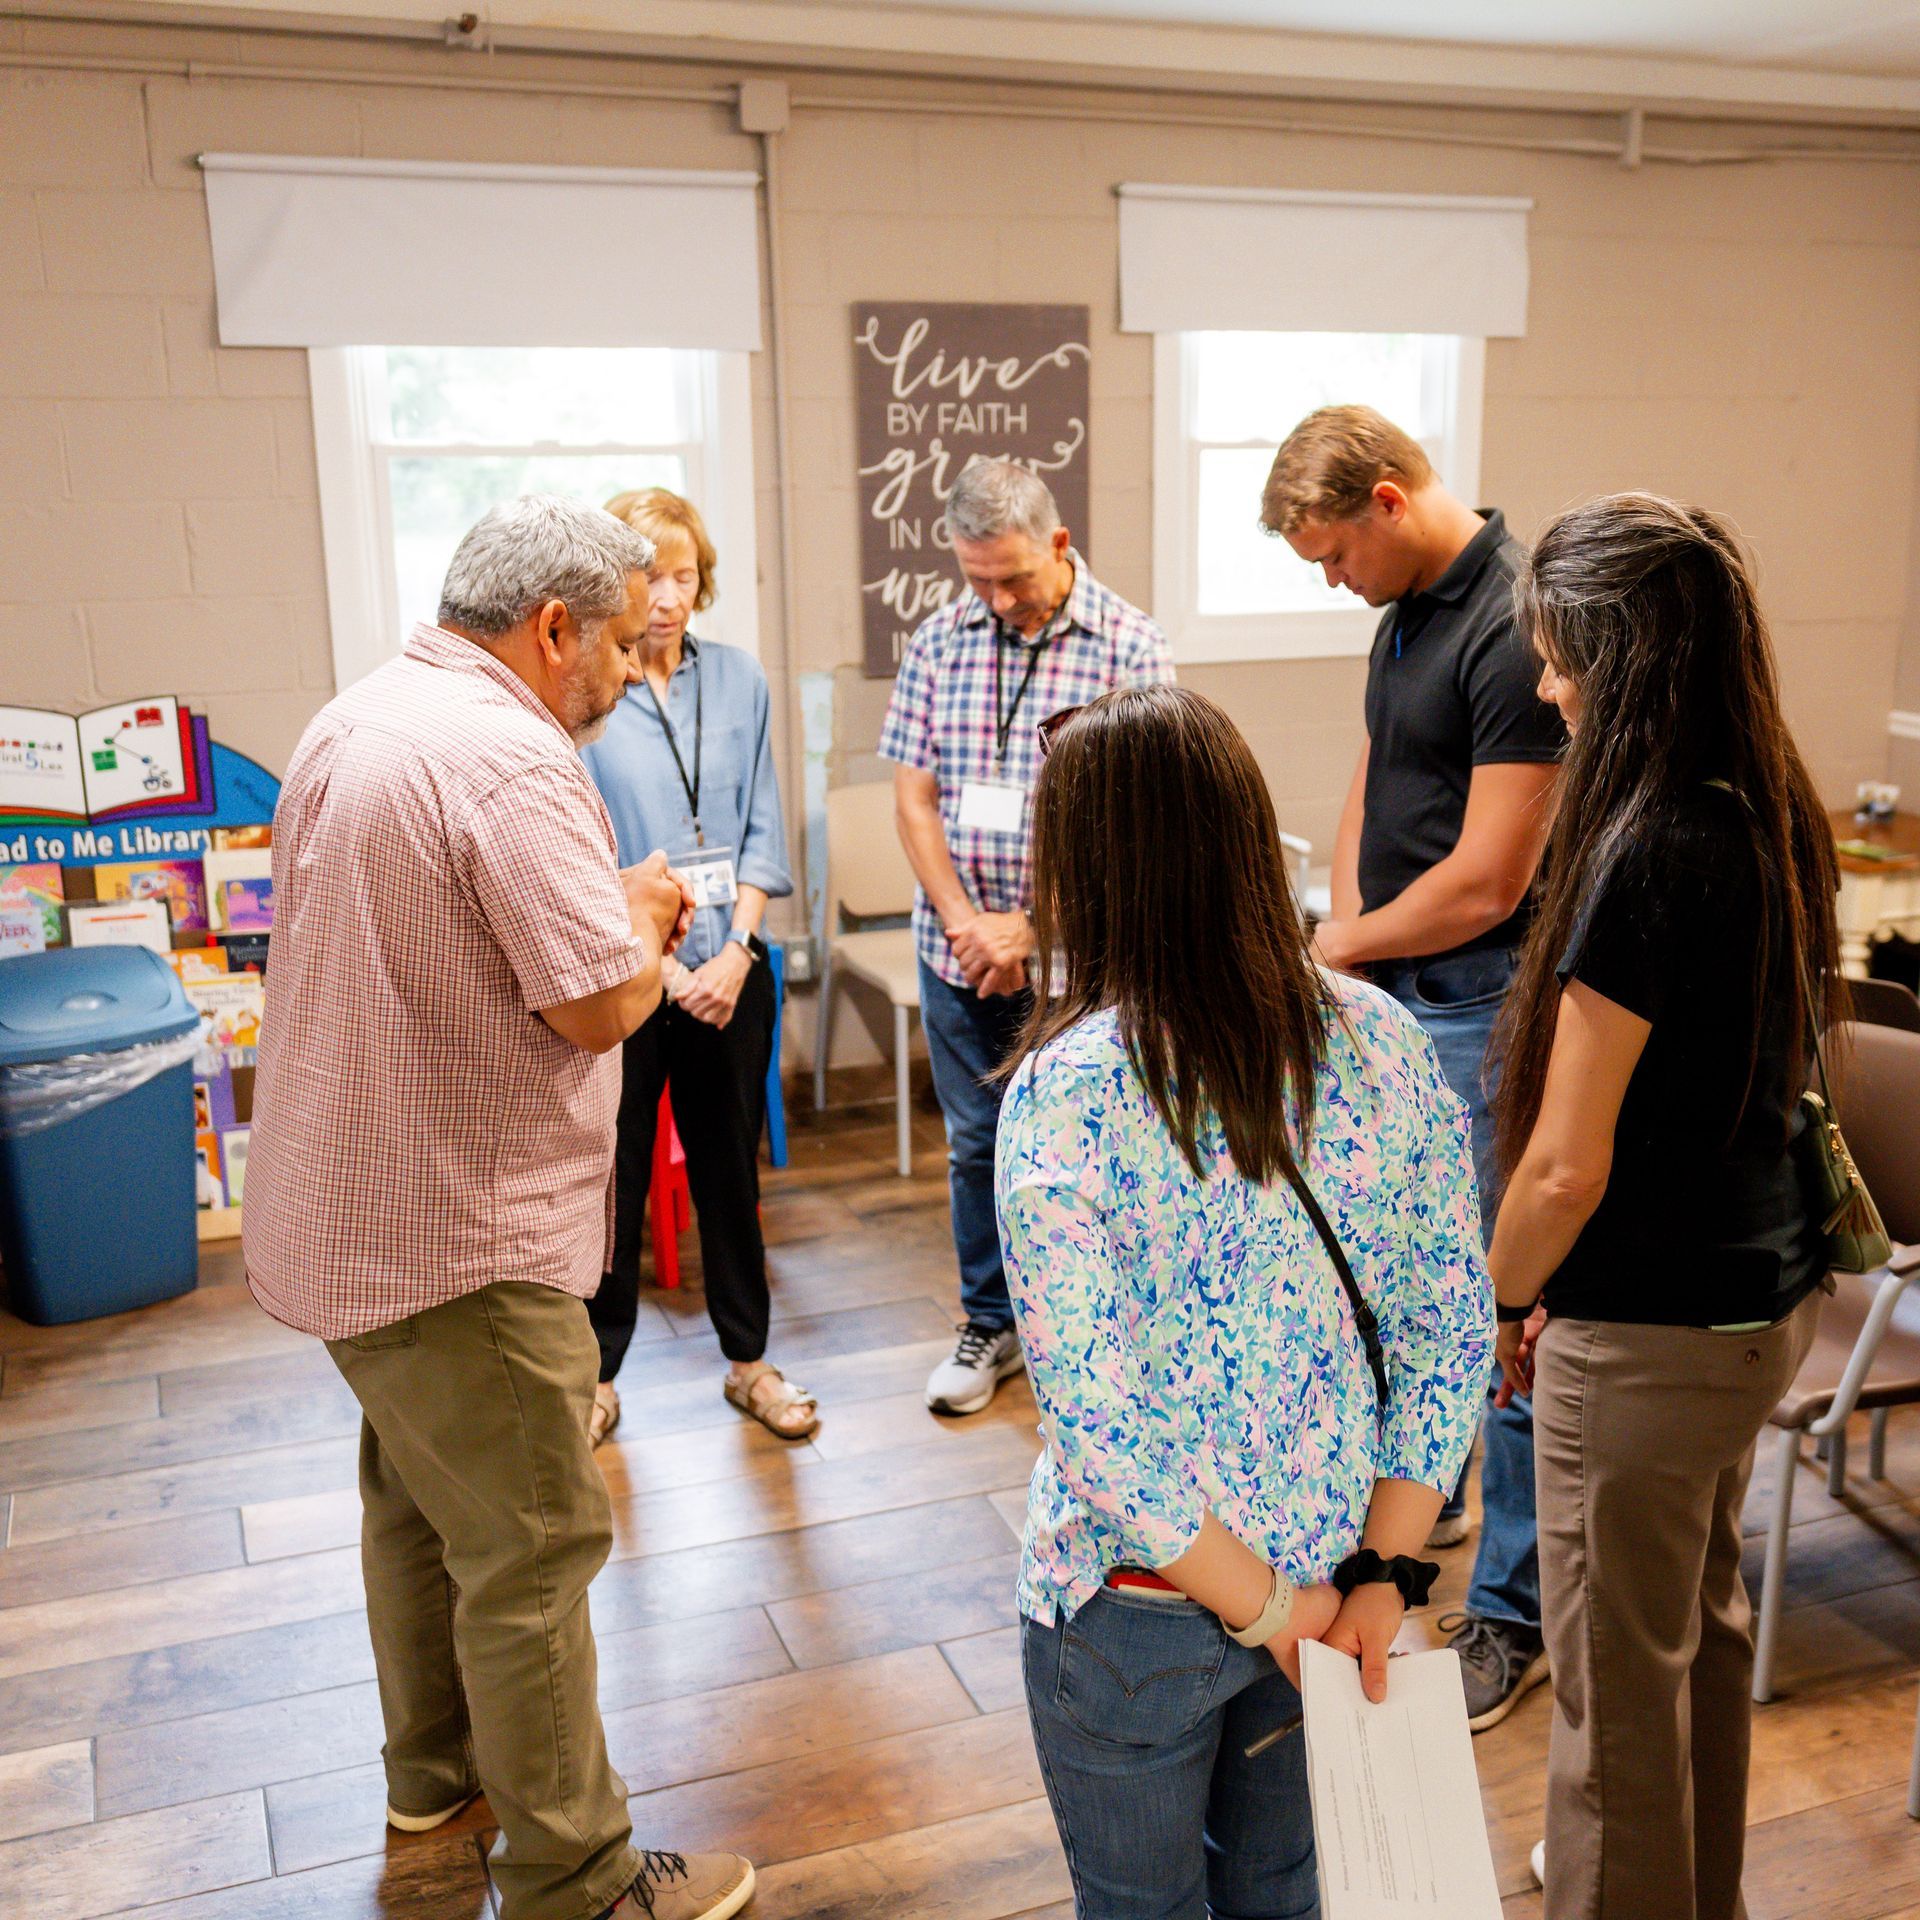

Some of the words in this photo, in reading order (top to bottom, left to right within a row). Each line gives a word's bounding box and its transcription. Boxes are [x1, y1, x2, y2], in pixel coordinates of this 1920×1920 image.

[854, 315, 1091, 399] live
[887, 403, 929, 437] BY
[937, 403, 1027, 435] FAITH
[889, 517, 922, 549] IN
[862, 567, 954, 621] wa
[0, 834, 28, 863] ad
[35, 835, 65, 860] to
[72, 830, 114, 858] Me
[119, 826, 212, 854] Library
